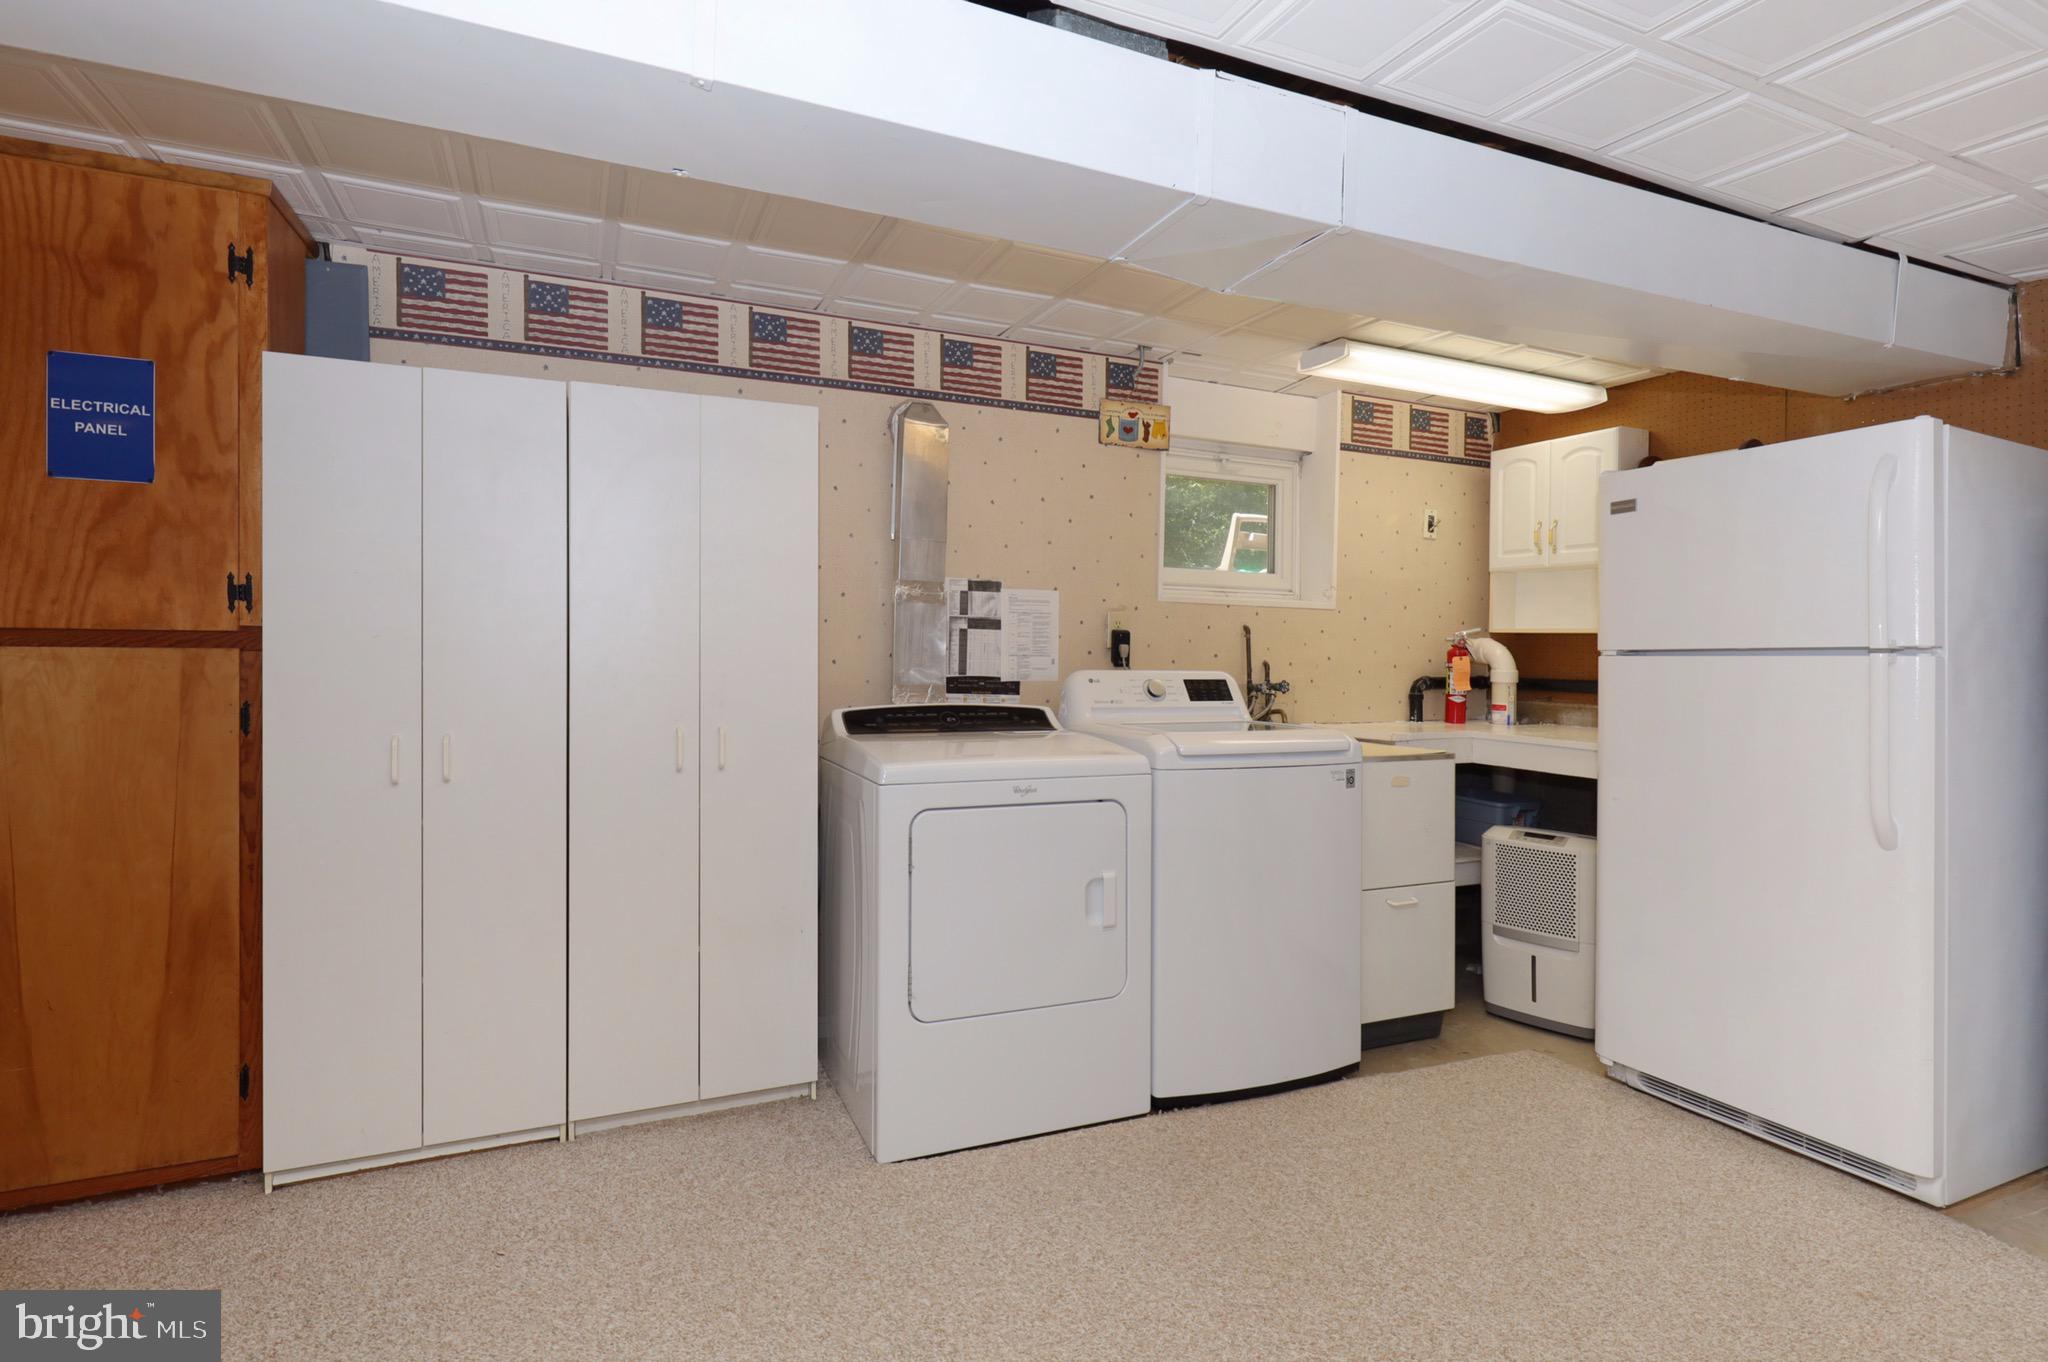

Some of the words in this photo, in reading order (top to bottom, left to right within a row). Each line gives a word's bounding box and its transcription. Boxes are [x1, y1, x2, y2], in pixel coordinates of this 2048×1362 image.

[371, 254, 382, 325] AMERICA
[501, 272, 512, 340] AMERICA
[620, 288, 629, 353] AMERICA
[49, 397, 151, 417] ELECTRICAL
[74, 421, 128, 437] PANEL
